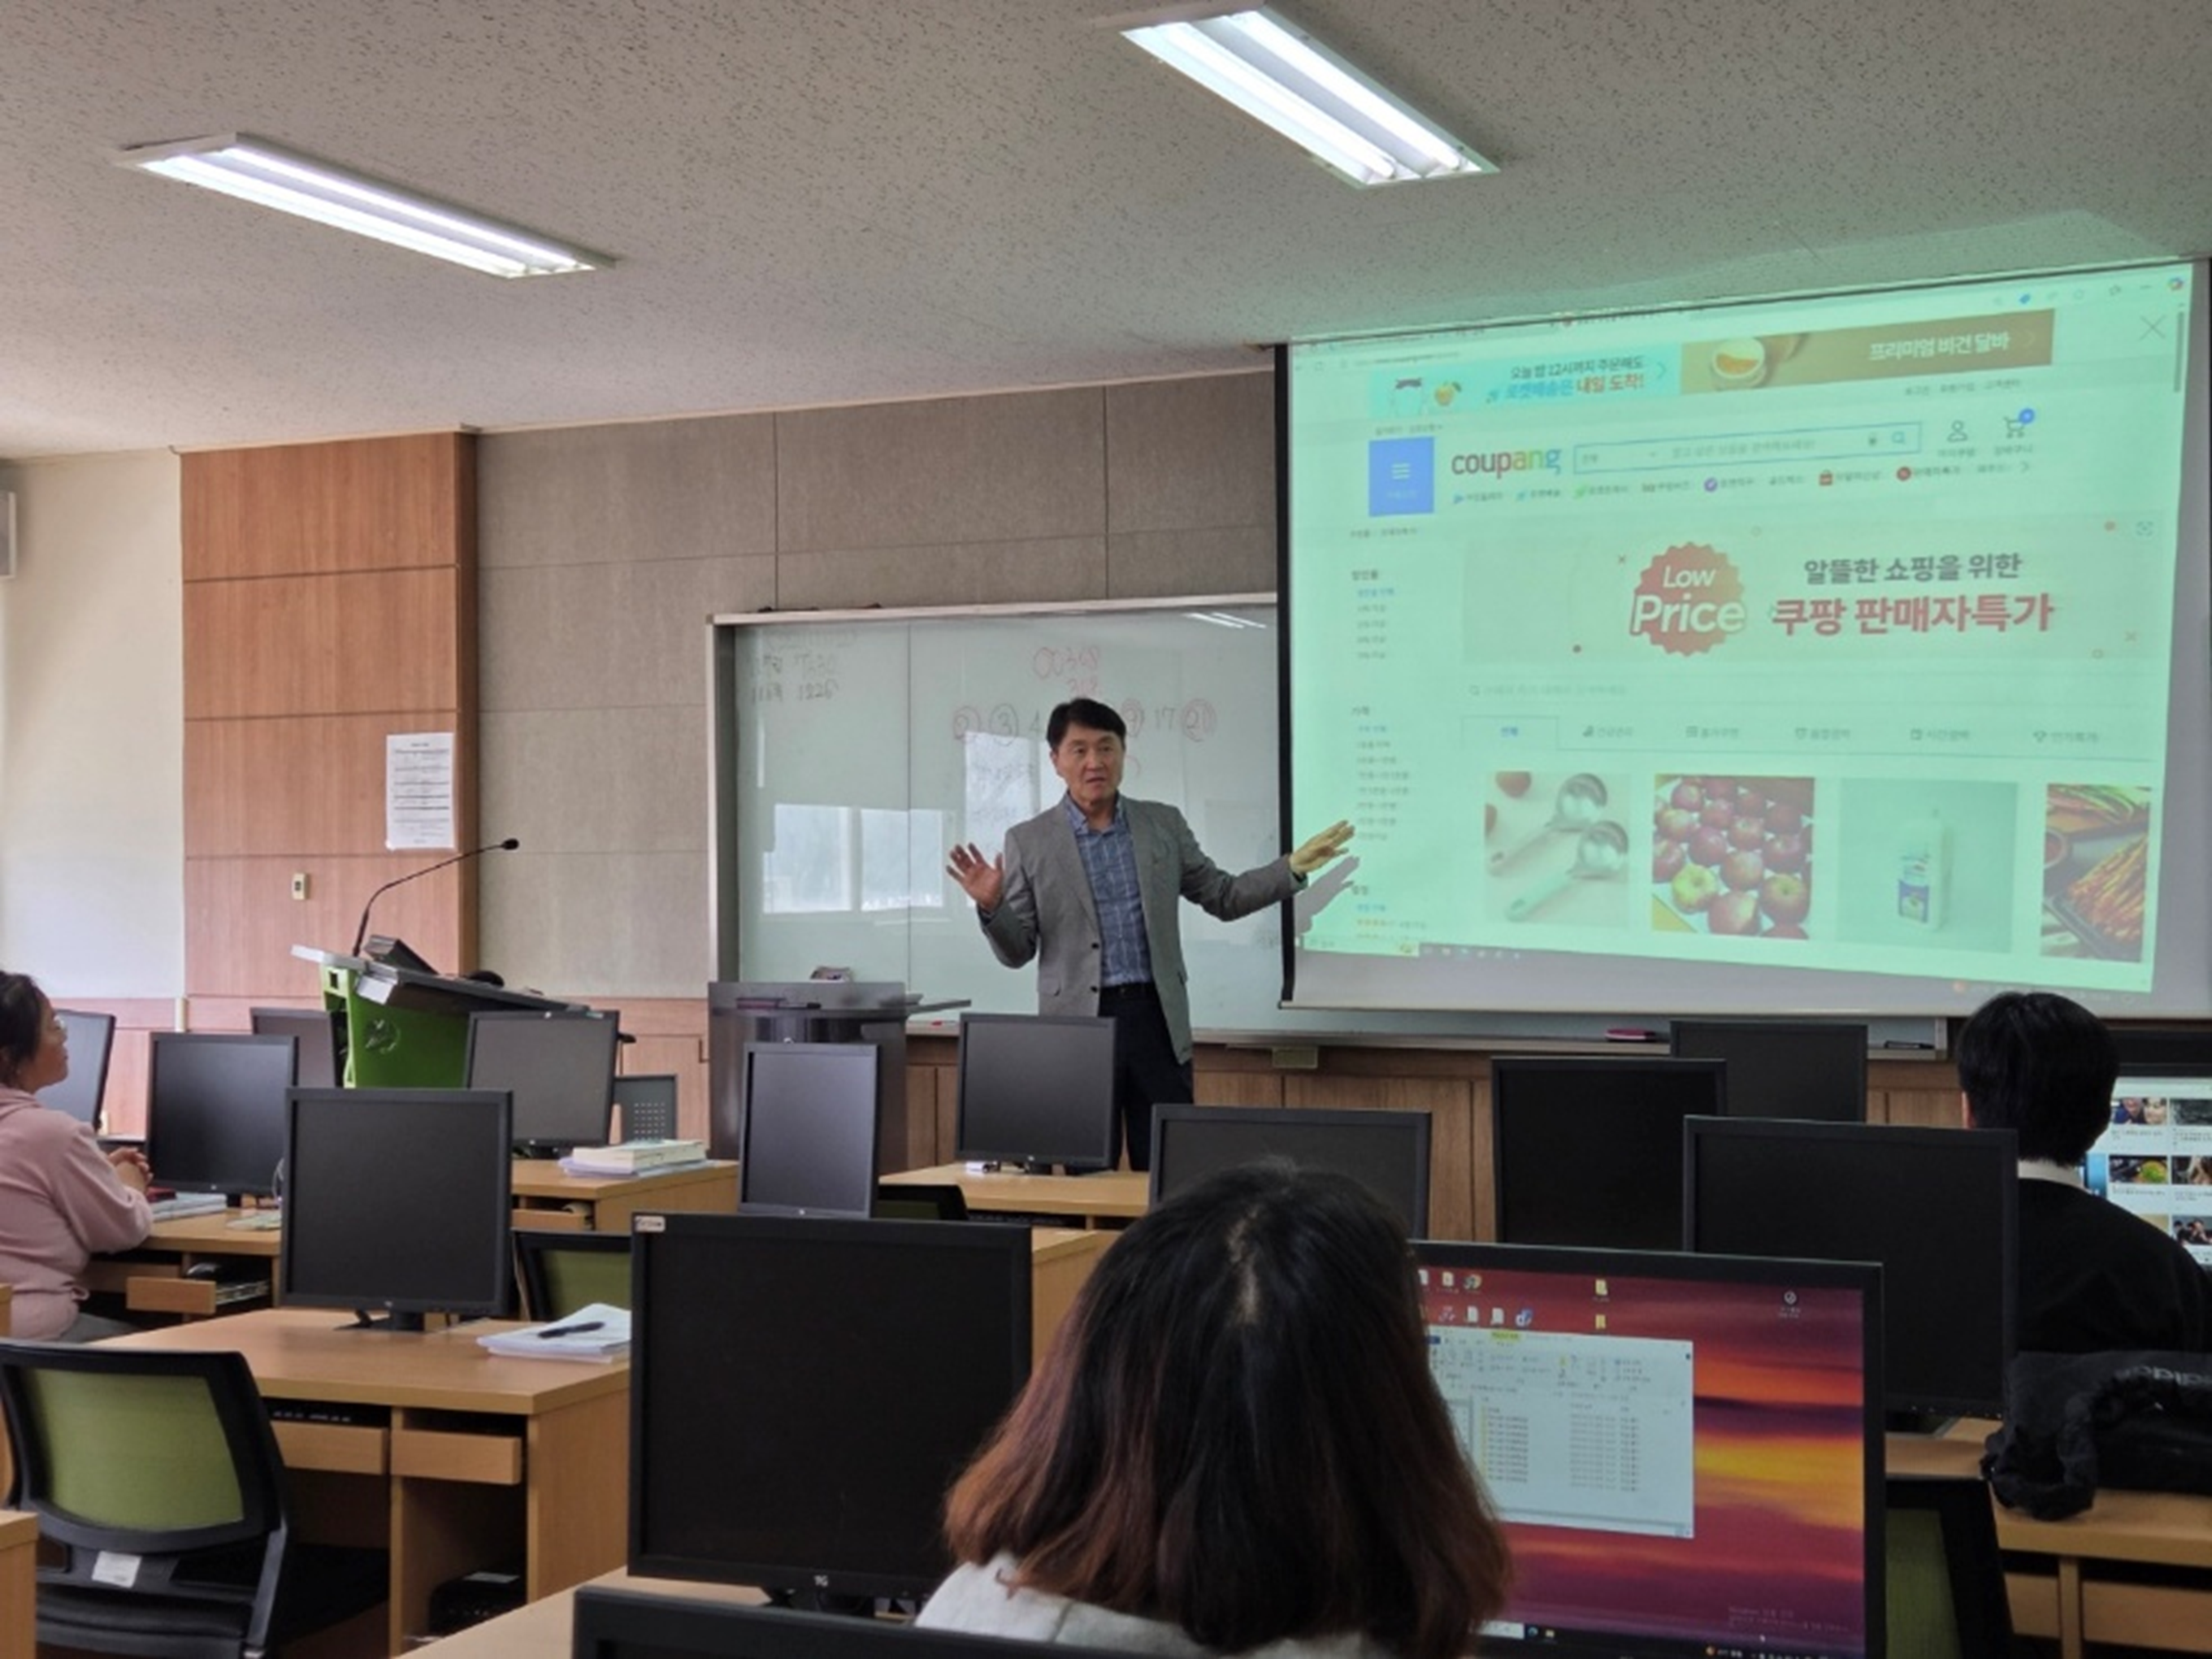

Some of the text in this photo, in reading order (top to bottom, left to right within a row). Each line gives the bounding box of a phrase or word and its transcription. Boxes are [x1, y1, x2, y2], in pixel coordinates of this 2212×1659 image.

[1869, 331, 2010, 361] 프리미엄 비건 달바
[1511, 366, 1531, 380] 오늘
[1547, 359, 1595, 377] 12시까지
[1577, 376, 1606, 395] 내일
[1608, 372, 1645, 392] 도착!
[1451, 449, 1562, 480] coupang
[1663, 565, 1715, 589] Low
[1804, 552, 2022, 585] 알뜰한 쇼핑을 위한
[1629, 594, 1746, 636] Price
[1772, 593, 2054, 636] 쿠팡 판매자특가
